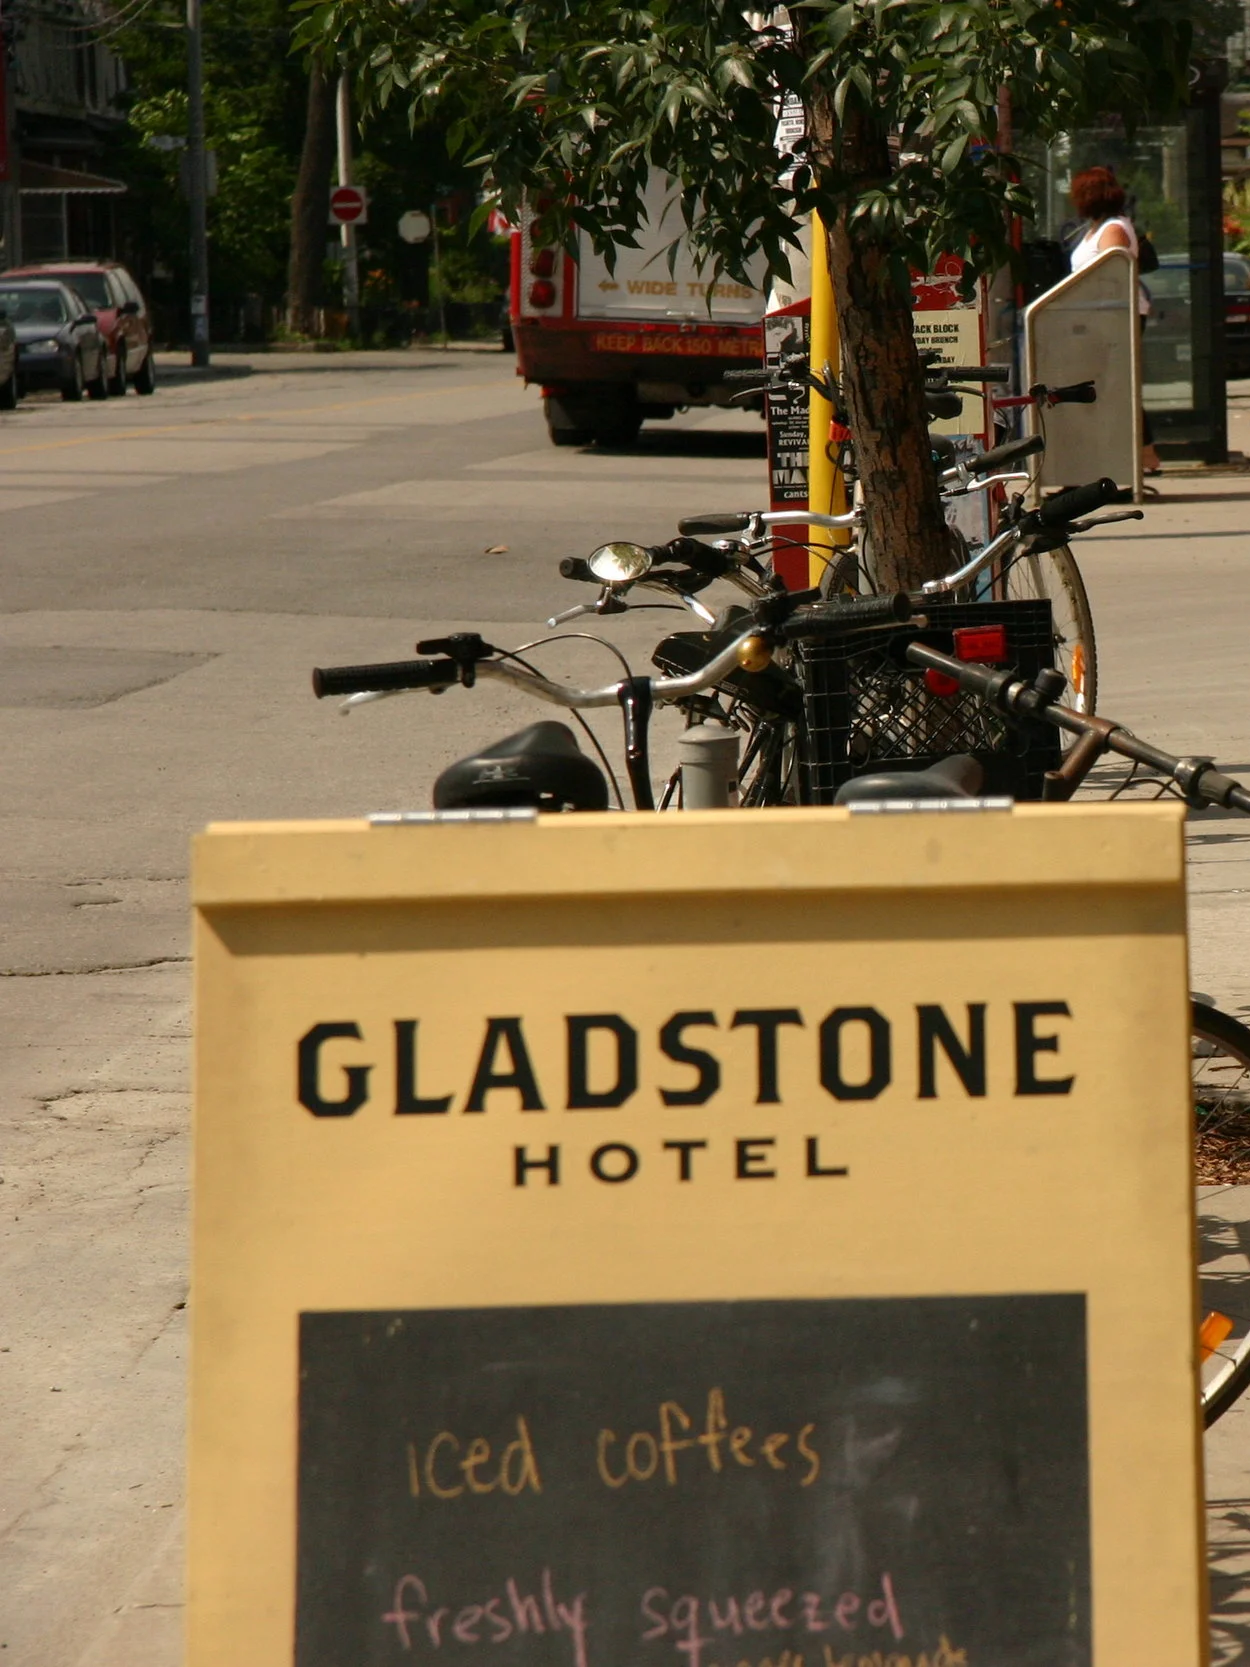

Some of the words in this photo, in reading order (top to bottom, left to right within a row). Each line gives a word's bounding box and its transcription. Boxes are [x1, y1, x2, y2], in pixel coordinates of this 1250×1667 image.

[626, 280, 678, 296] WIDE
[687, 281, 754, 299] TURNS
[914, 324, 932, 334] ACK
[933, 323, 960, 333] BLOCK
[596, 334, 637, 351] KEEP
[643, 336, 684, 353] BACK
[686, 338, 709, 354] 150
[718, 339, 764, 357] METR
[770, 406, 788, 416] The
[778, 438, 809, 446] REVIVA
[772, 469, 809, 485] MA
[297, 1001, 1077, 1119] GLADSTONE
[512, 1135, 850, 1187] HOTEL
[406, 1413, 543, 1499] iced
[597, 1387, 820, 1489] coffees
[383, 1567, 588, 1667] freshly
[640, 1571, 904, 1667] squeezed
